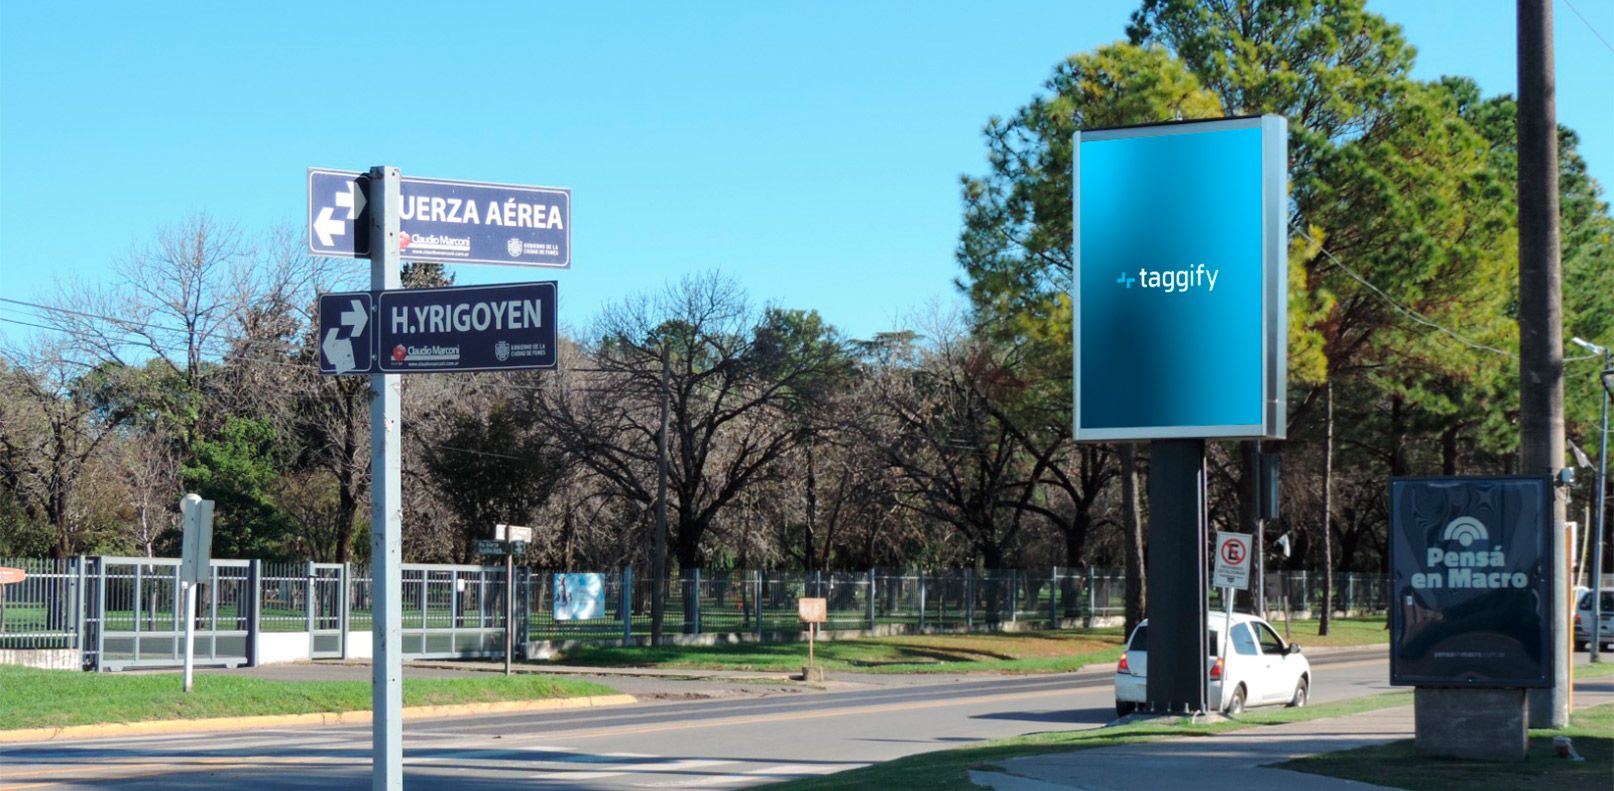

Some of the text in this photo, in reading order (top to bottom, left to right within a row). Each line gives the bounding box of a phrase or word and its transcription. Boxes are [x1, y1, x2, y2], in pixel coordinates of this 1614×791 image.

[400, 194, 563, 230] UERZA AÉREA
[411, 233, 470, 247] Claudio Marconi
[1139, 263, 1219, 293] taggify
[391, 299, 542, 334] H.YRIGOYEN
[407, 344, 460, 356] Claudio Marconi
[1426, 545, 1505, 567] Pensá
[1410, 567, 1528, 589] en Macro
